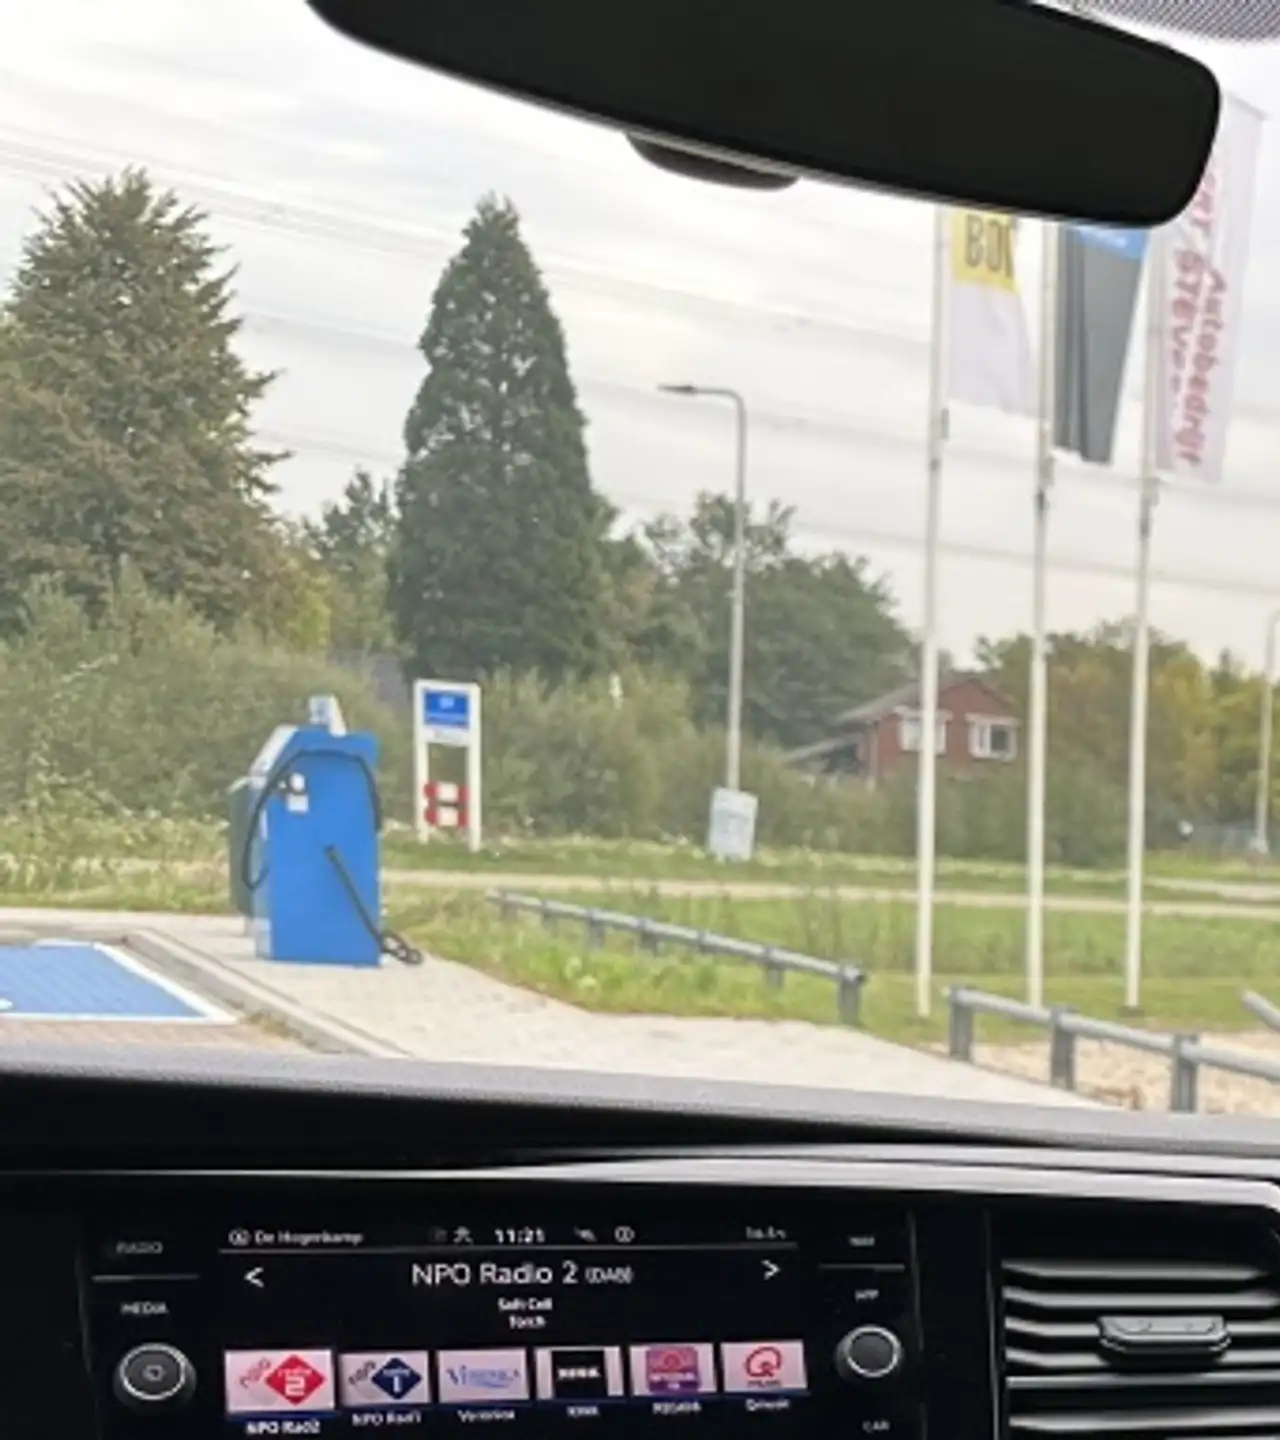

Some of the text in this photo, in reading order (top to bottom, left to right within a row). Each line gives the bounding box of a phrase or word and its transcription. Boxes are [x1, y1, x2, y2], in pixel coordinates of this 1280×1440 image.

[494, 1226, 545, 1243] 11:21
[412, 1262, 471, 1286] NPO
[480, 1261, 553, 1285] Radio
[561, 1259, 578, 1285] 2
[121, 1300, 168, 1315] MEDIA
